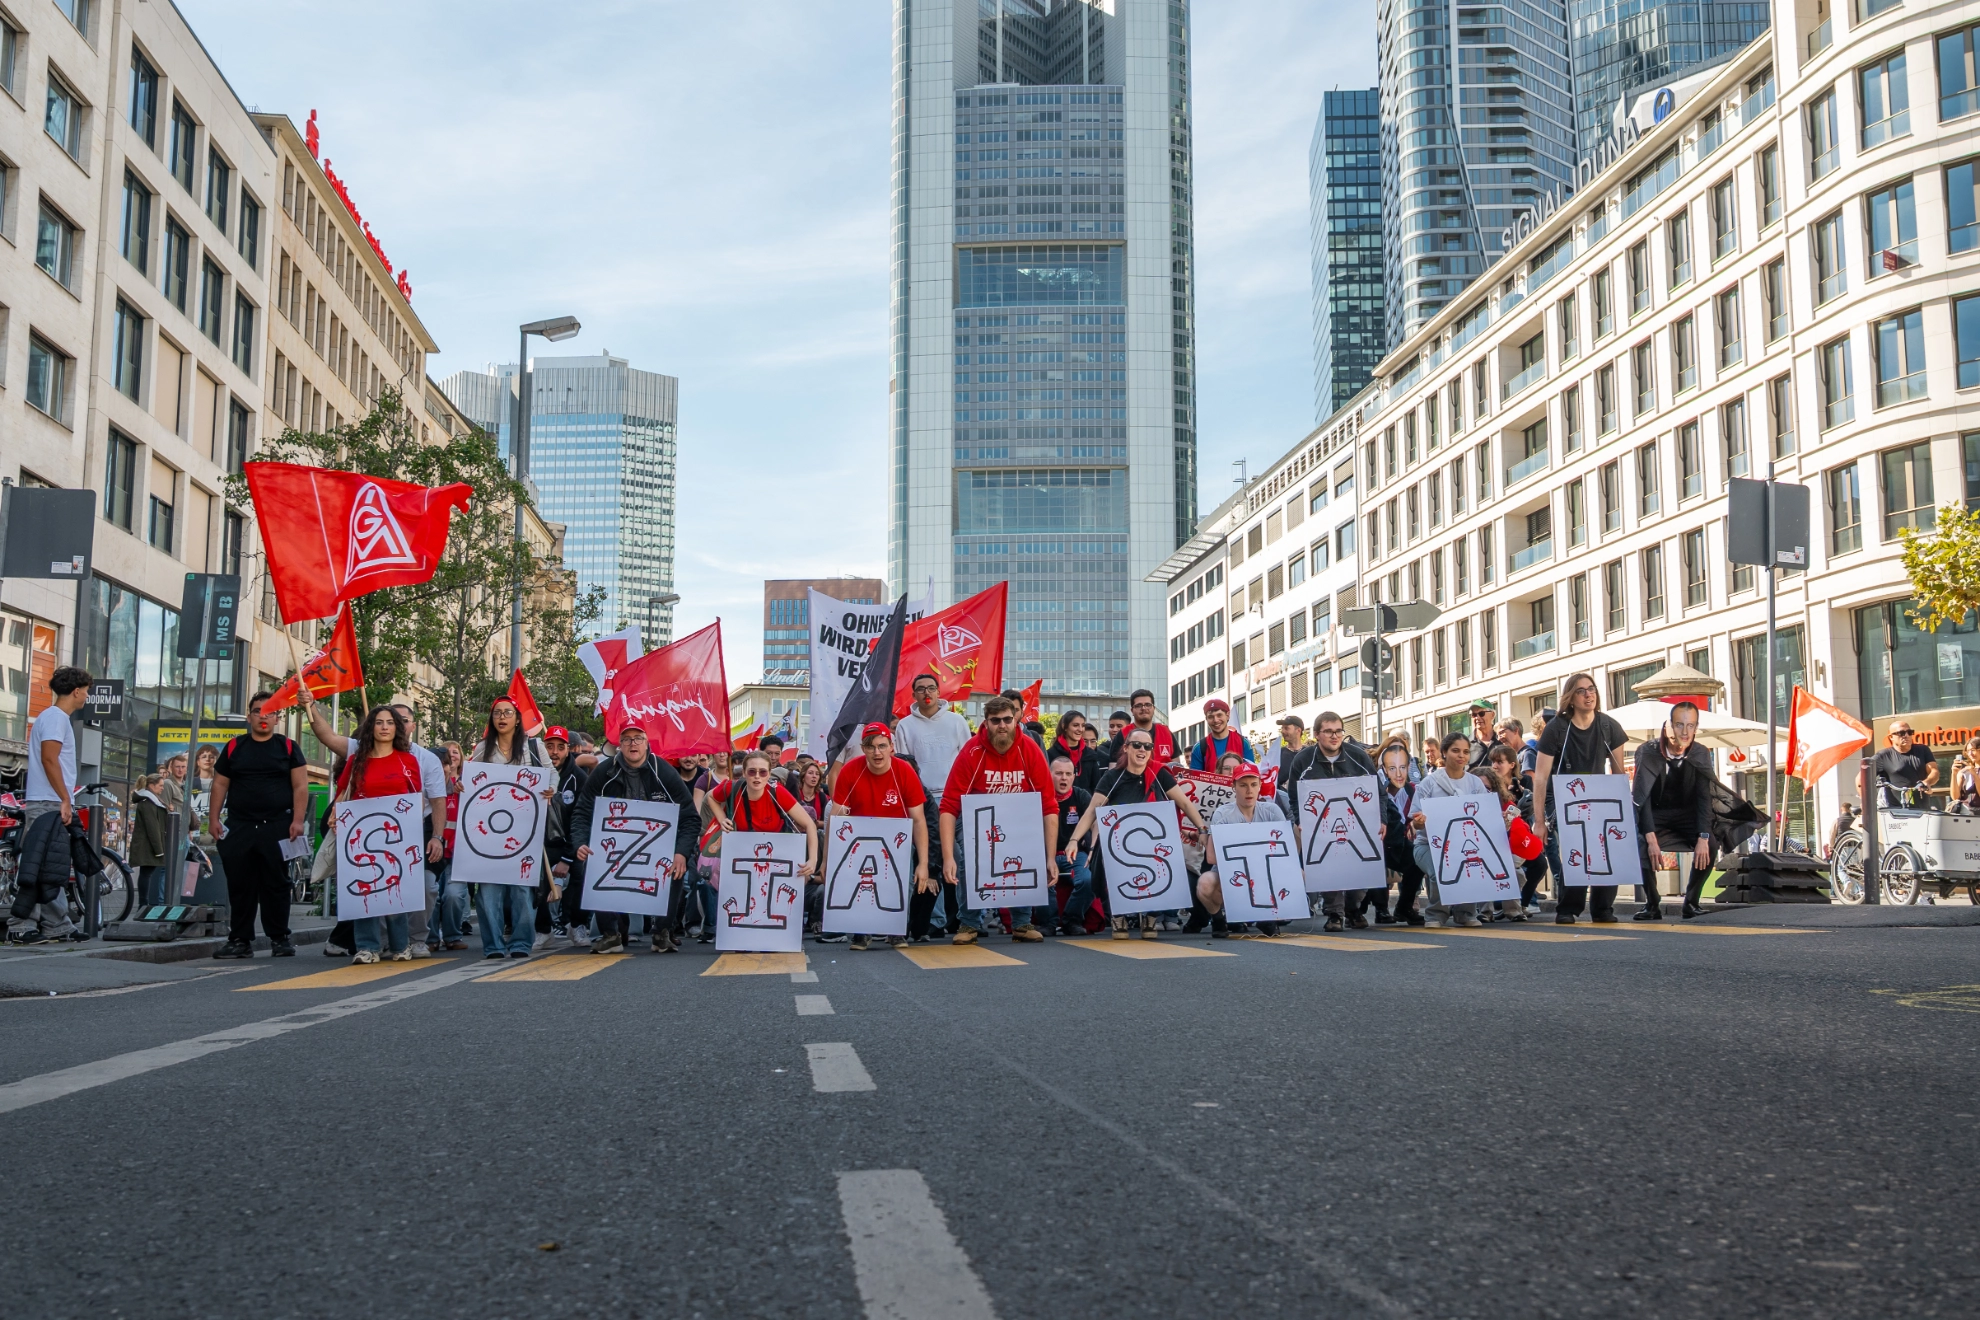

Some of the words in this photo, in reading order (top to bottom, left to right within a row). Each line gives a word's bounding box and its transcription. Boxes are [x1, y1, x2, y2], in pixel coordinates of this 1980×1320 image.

[1571, 117, 1641, 196] IDUNA
[820, 624, 868, 658] WIRD
[842, 612, 885, 634] OHNE
[1912, 725, 1980, 747] antan
[984, 770, 1026, 784] TARIF
[1202, 784, 1237, 799] Arbe
[345, 812, 403, 896] S
[462, 782, 538, 859] O
[975, 806, 1037, 892] L
[1108, 812, 1172, 899] S
[1306, 797, 1381, 865] A
[1439, 817, 1509, 884] A
[1565, 799, 1623, 875] T
[593, 817, 671, 896] Z
[827, 837, 904, 912] A
[1223, 841, 1289, 908] T
[728, 858, 793, 929] I
